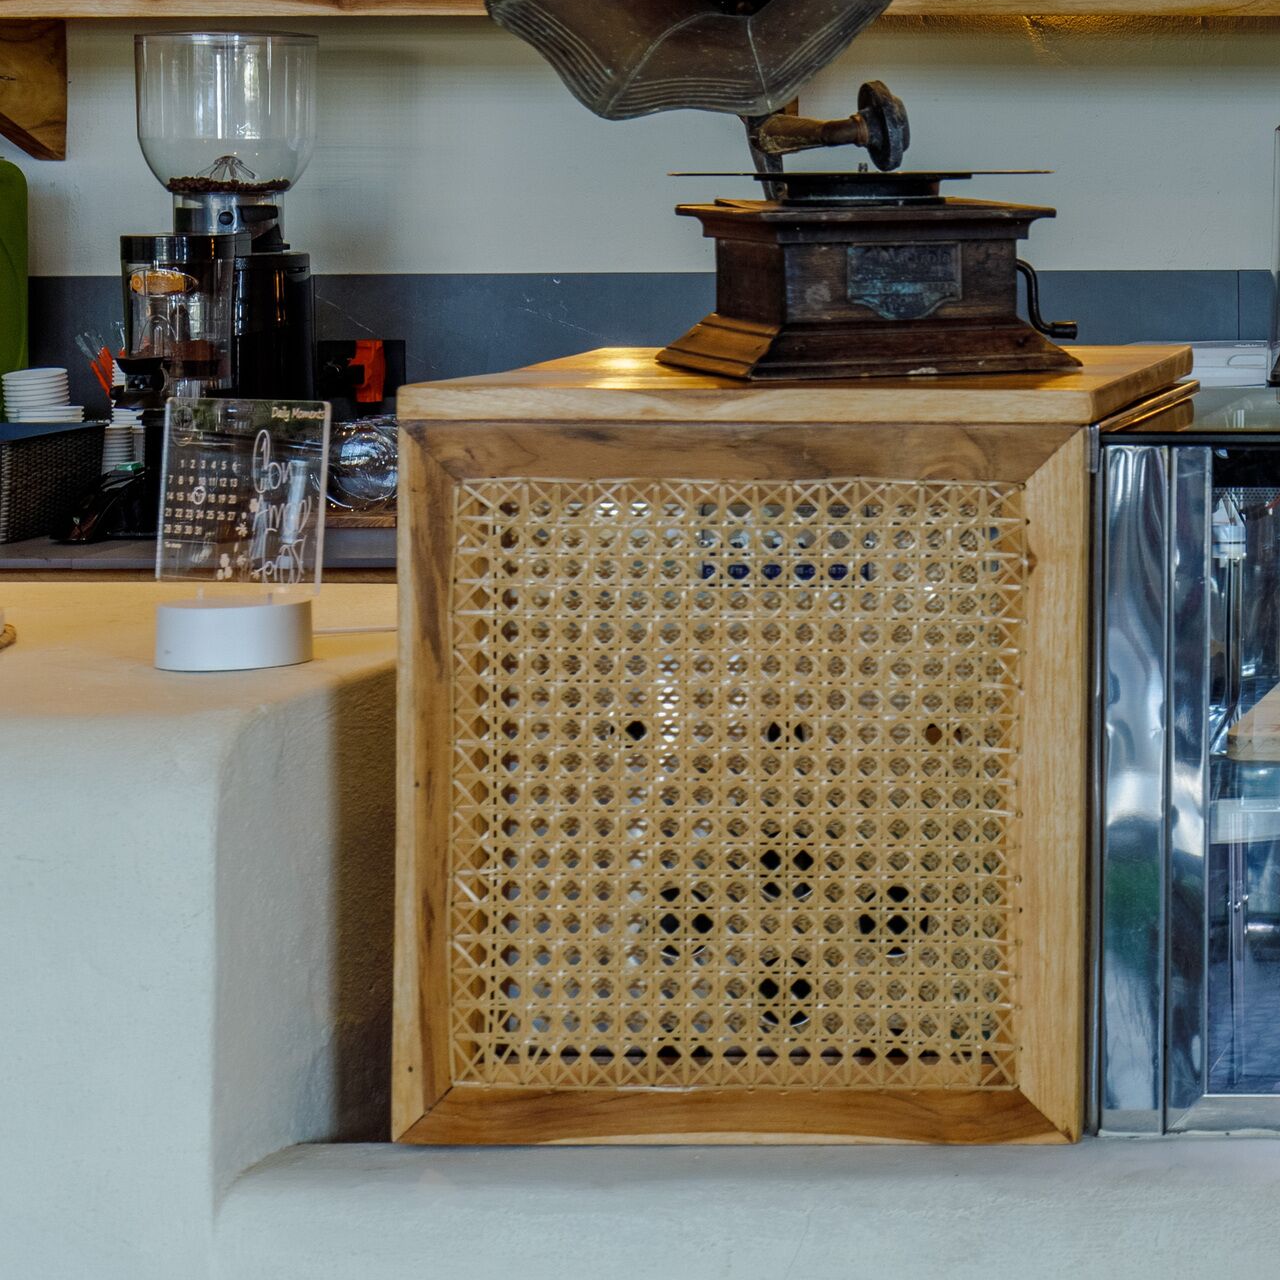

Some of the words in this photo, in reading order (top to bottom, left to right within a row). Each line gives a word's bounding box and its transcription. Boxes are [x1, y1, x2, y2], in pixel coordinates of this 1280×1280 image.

[271, 406, 290, 422] Daily
[180, 459, 184, 469] 1
[190, 460, 196, 469] 2
[200, 460, 206, 470] 3
[210, 460, 217, 470] 4
[221, 460, 227, 470] 5
[168, 475, 174, 484] 7
[178, 476, 184, 485] 8
[188, 476, 194, 486] 9
[208, 477, 216, 486] 11
[219, 478, 227, 487] 12
[230, 478, 238, 488] 13
[166, 492, 174, 501] 14
[176, 492, 184, 501] 15
[208, 494, 216, 503] 18
[218, 494, 226, 504] 19
